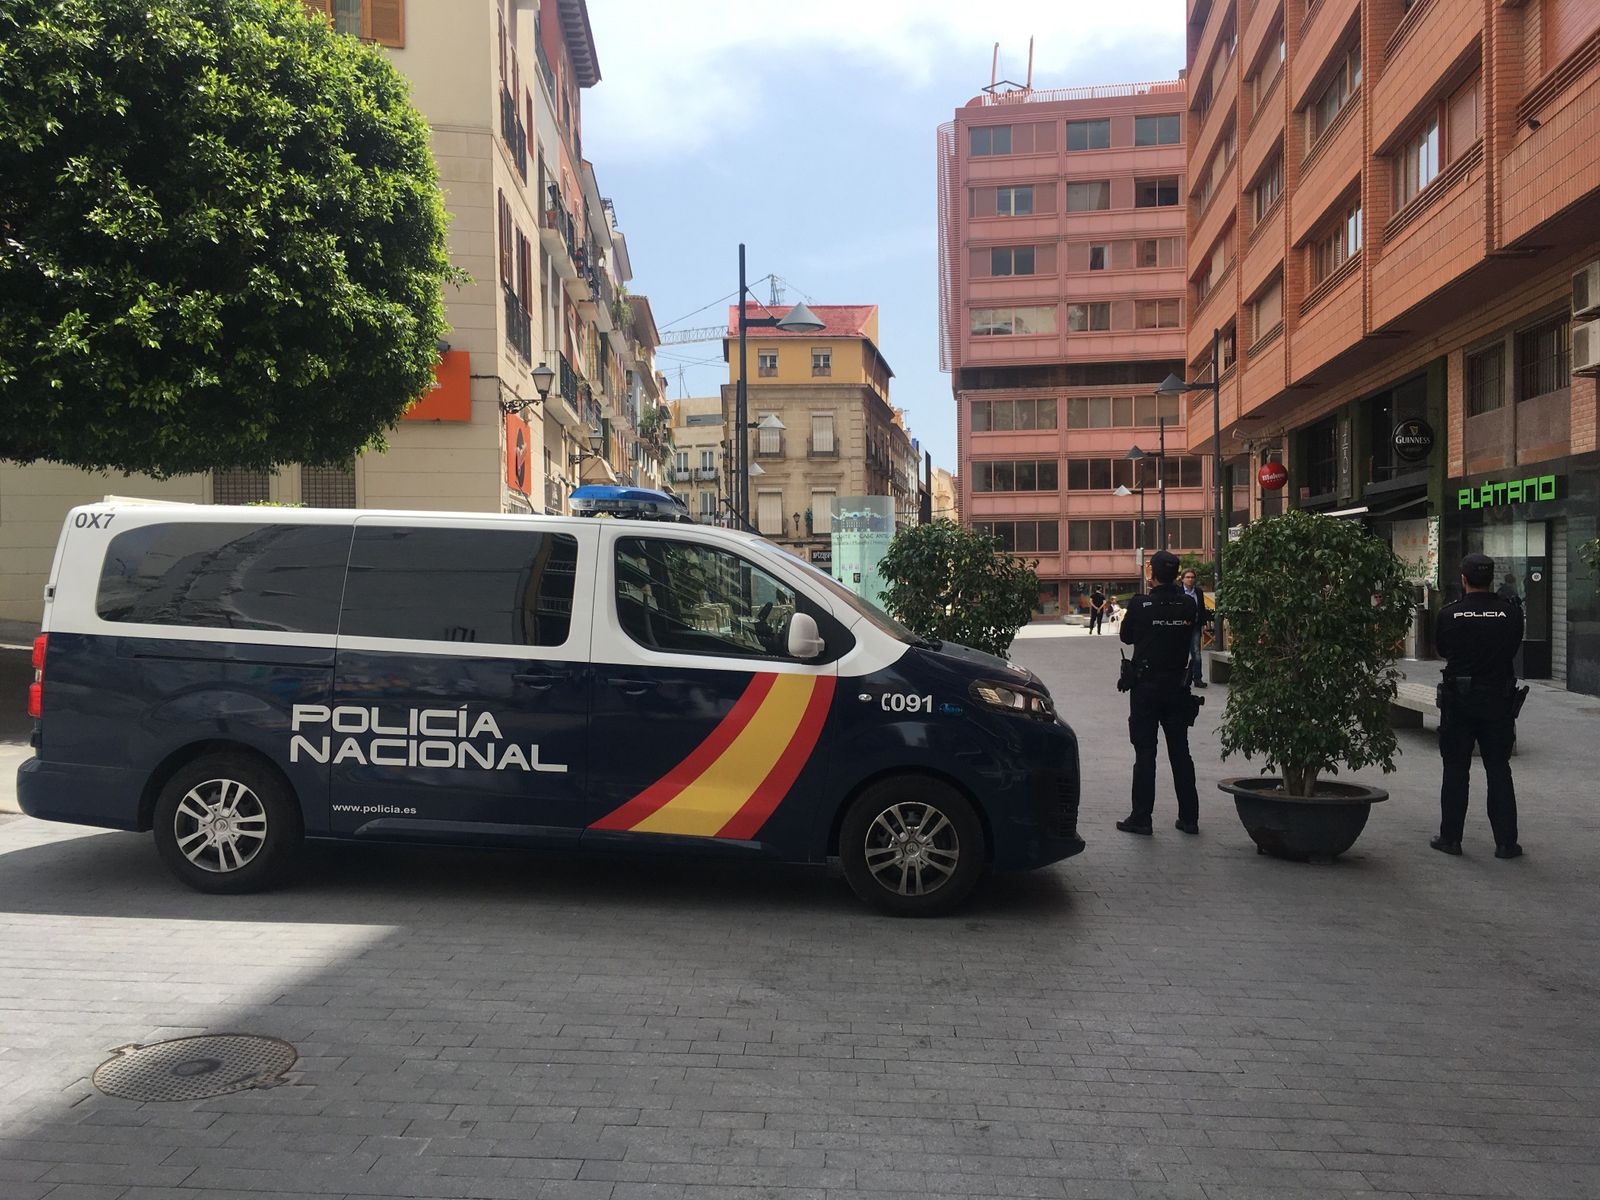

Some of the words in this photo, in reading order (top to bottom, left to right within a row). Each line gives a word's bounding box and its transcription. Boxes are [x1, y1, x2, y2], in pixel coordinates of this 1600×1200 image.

[1395, 435, 1431, 444] GUINNESS
[1453, 611, 1507, 619] POLICIA
[890, 693, 933, 713] 091
[291, 703, 503, 739] POLICÍA
[289, 734, 568, 773] NACIONAL
[332, 803, 417, 815] www.policia.es
